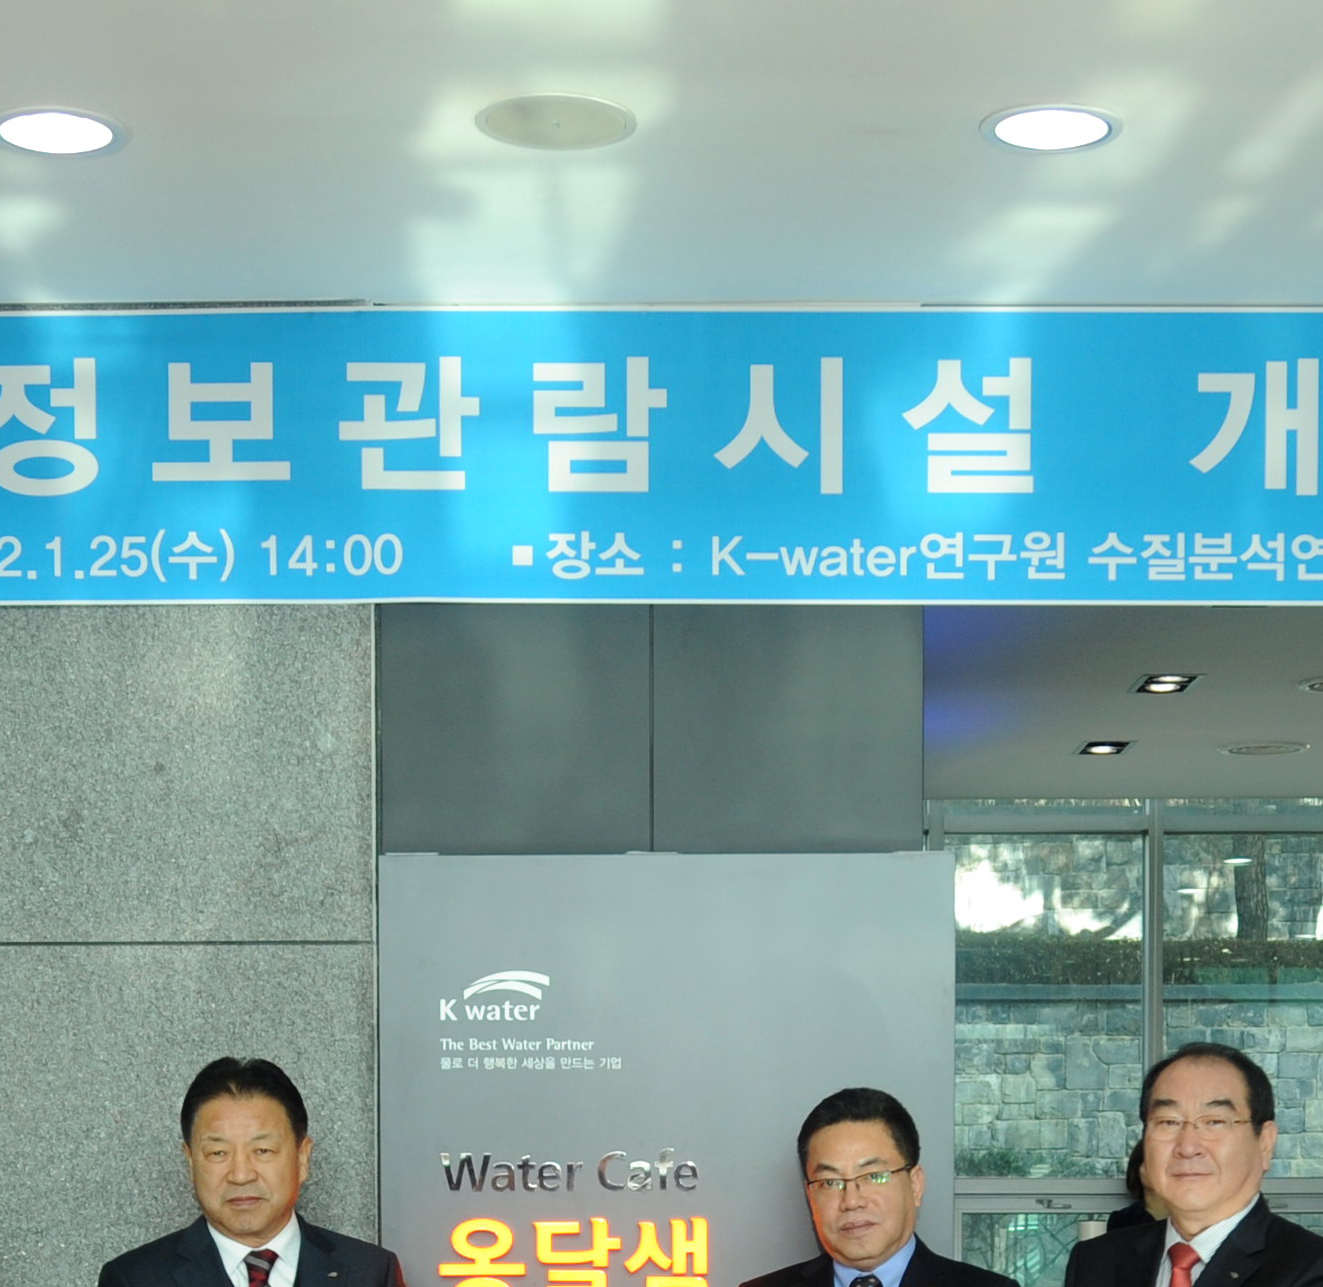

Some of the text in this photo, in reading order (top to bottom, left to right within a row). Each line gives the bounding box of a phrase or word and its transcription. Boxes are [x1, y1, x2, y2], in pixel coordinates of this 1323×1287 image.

[260, 533, 403, 576] 14:00
[545, 531, 645, 580] 장소
[711, 532, 1067, 580] K-water연구원
[439, 999, 541, 1021] K water
[440, 1038, 595, 1051] The Best Water Partner
[599, 1057, 622, 1070] 기업
[439, 1147, 700, 1193] Water Cafe
